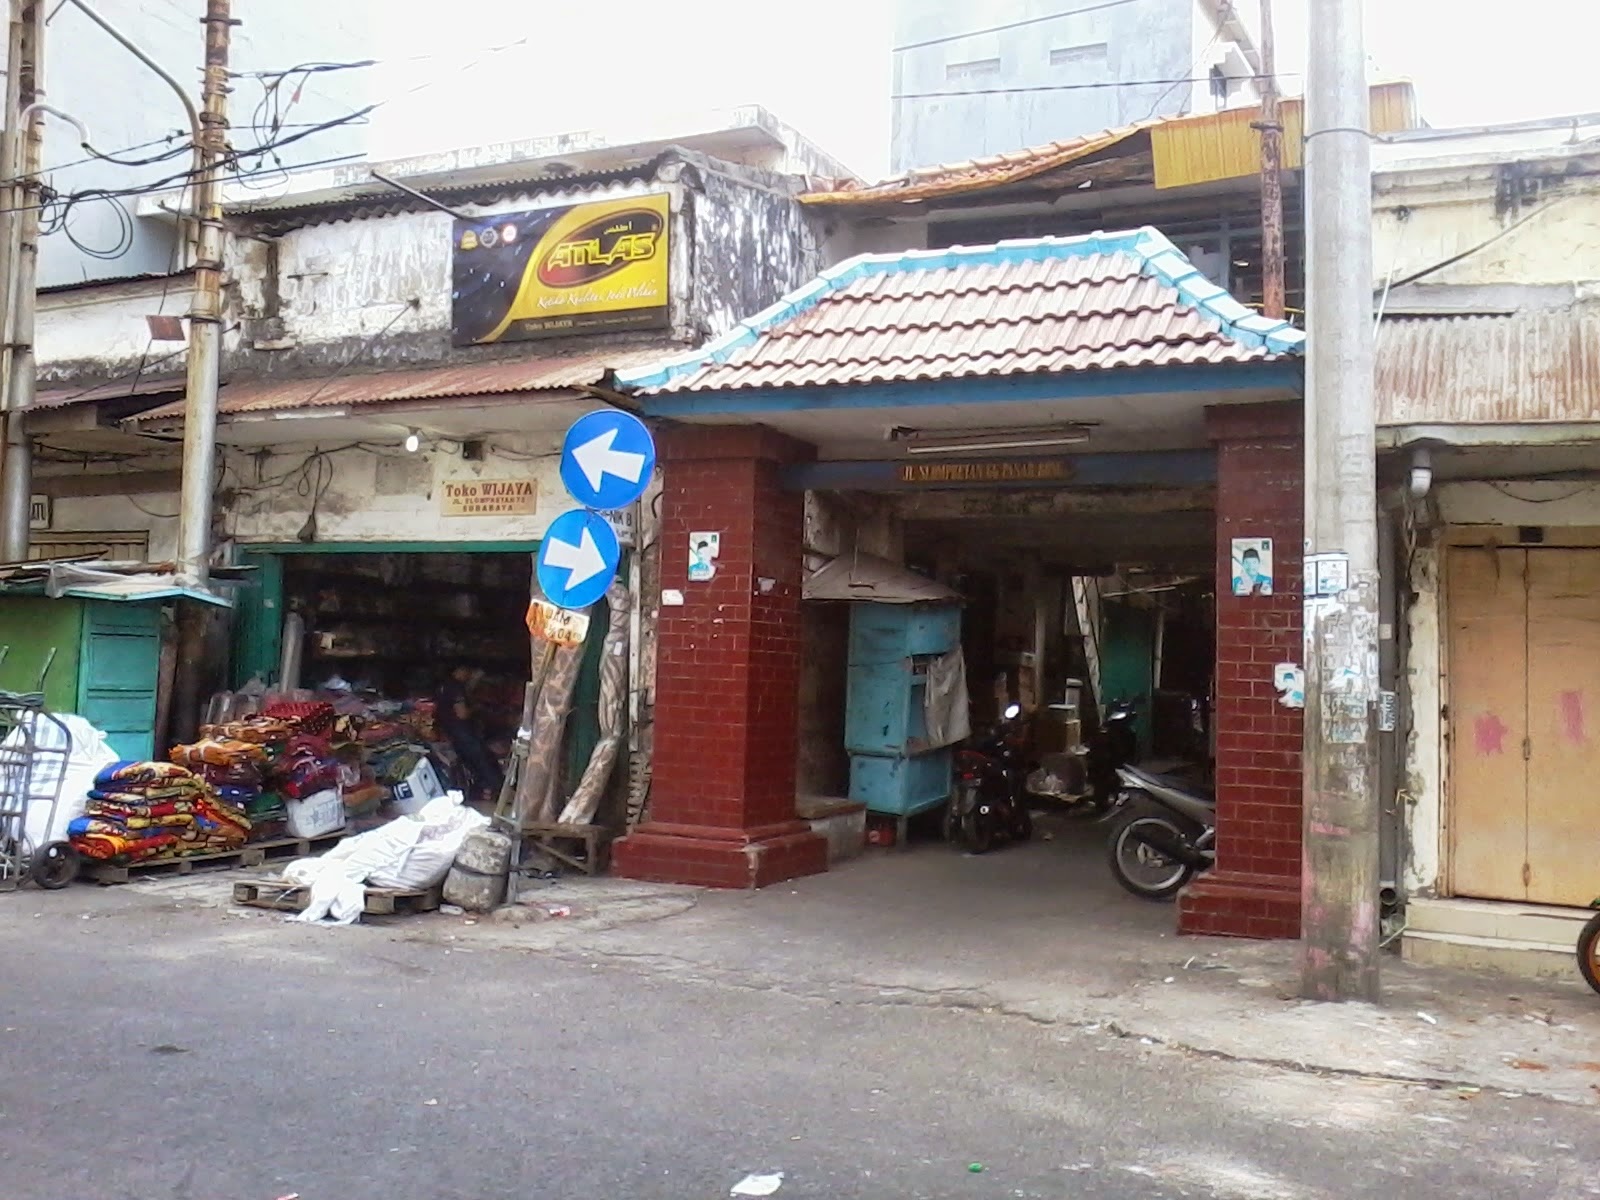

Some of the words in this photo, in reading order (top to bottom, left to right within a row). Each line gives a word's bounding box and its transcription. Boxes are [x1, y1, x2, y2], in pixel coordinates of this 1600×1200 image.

[547, 232, 657, 272] ATLAS
[446, 484, 477, 497] Toko
[481, 482, 532, 496] WIJAYA
[463, 504, 513, 512] SURABAYA
